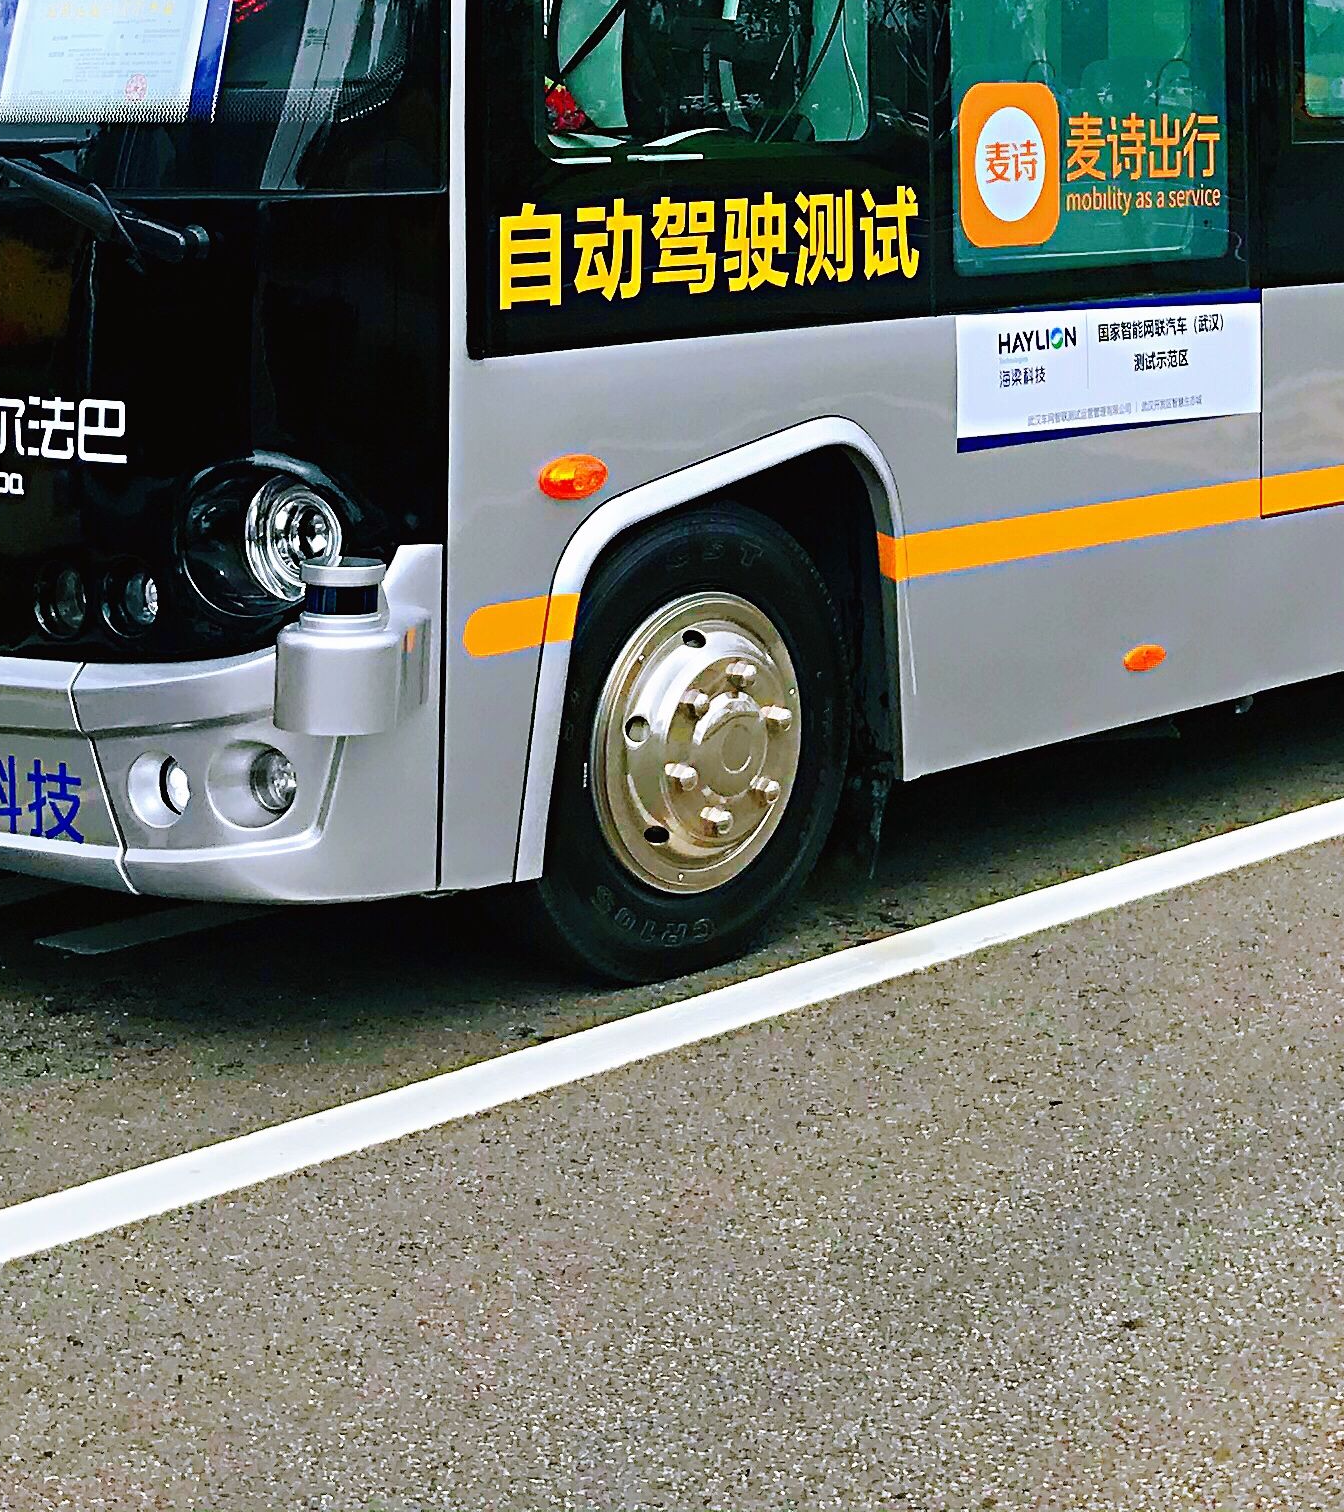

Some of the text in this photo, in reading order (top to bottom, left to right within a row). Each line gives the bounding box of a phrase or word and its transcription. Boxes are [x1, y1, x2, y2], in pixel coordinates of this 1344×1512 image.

[985, 139, 1038, 185] 麦诗
[1065, 111, 1221, 182] 麦诗出行
[1066, 183, 1221, 217] mobility as a service
[498, 185, 920, 311] 自动驾驶测试
[998, 325, 1077, 355] HAYLION
[1097, 312, 1225, 343] 国家智能网联汽车（武汉）
[1133, 348, 1190, 373] 测试示范区
[999, 366, 1046, 389] 海梁科技
